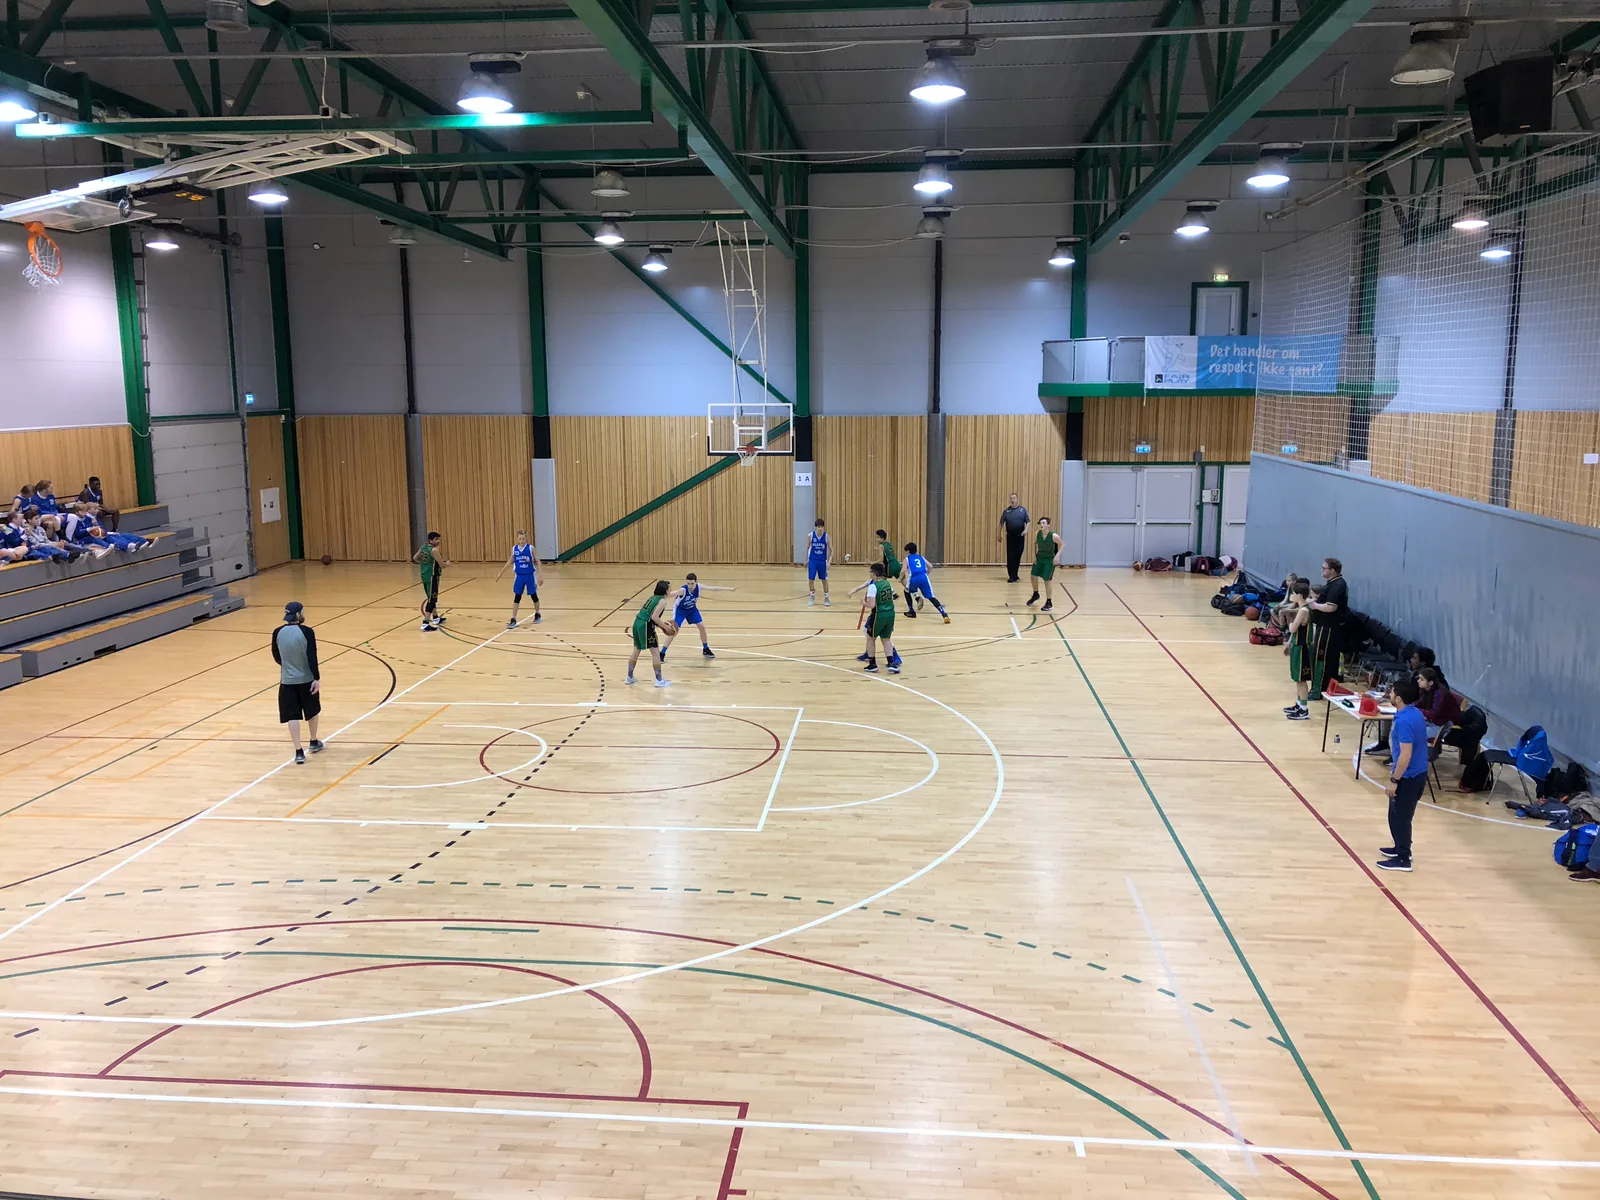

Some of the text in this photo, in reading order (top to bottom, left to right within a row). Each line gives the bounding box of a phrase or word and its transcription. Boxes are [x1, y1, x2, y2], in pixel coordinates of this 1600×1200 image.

[1210, 343, 1300, 360] Det handler om
[1209, 360, 1323, 377] respekt, ikke sant?
[914, 558, 922, 569] 3
